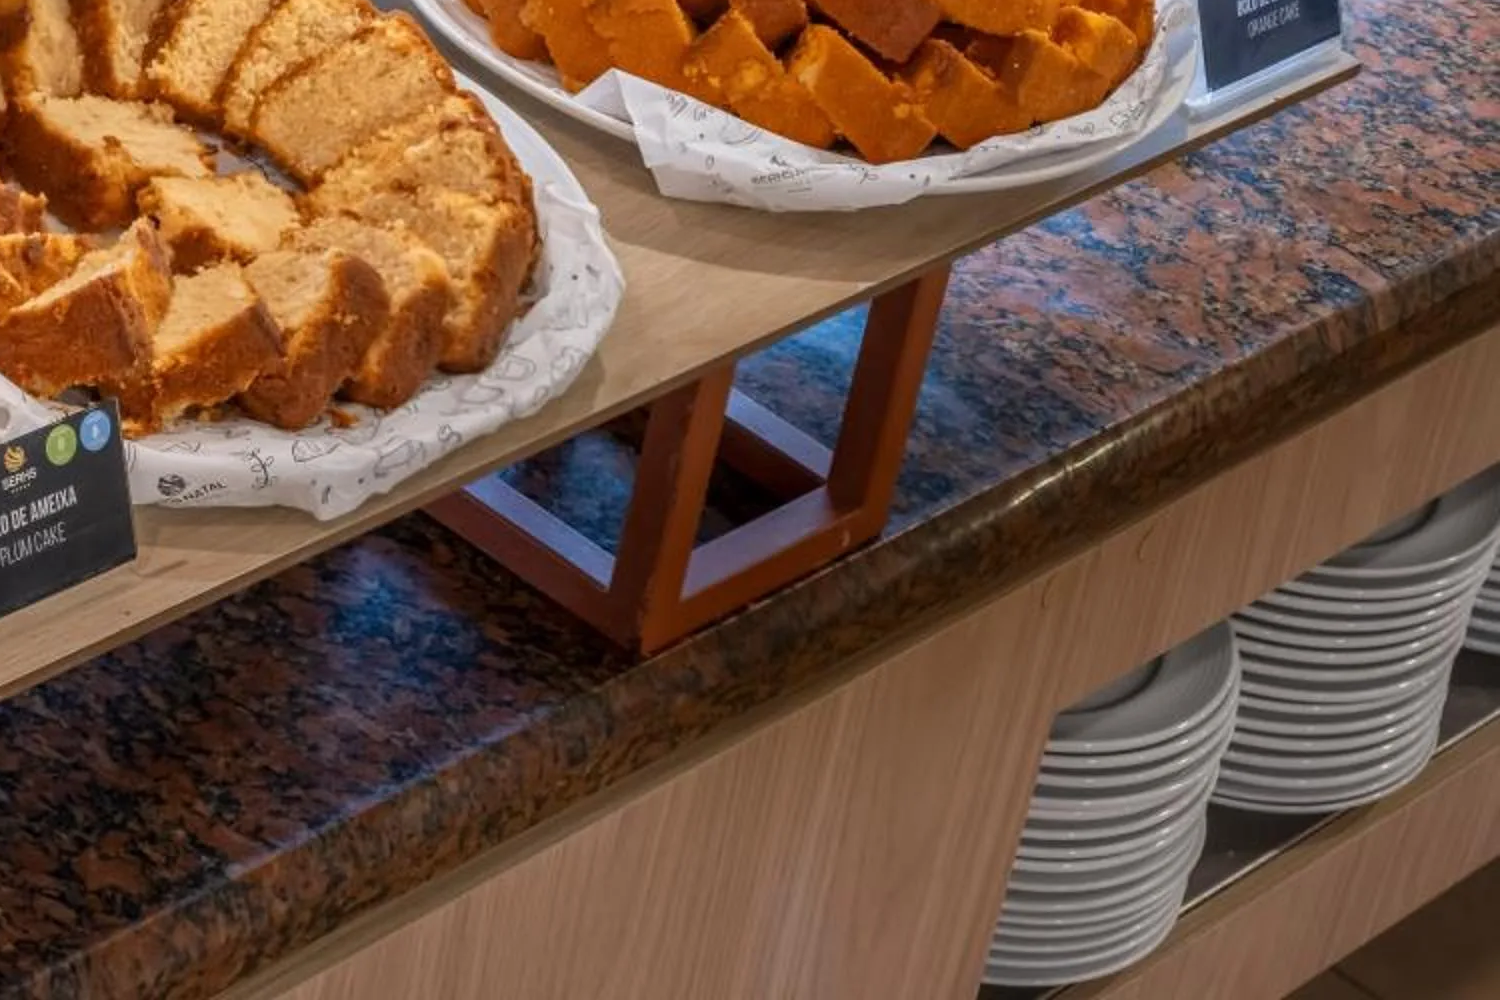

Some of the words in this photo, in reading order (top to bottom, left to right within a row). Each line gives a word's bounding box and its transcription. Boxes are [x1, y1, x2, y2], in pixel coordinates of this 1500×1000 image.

[1247, 9, 1280, 39] ORANGE
[1279, 0, 1301, 25] CAKE
[11, 506, 29, 530] DE
[30, 485, 78, 522] AMEIXA
[0, 537, 34, 568] PLUM
[35, 521, 67, 552] CAKE
